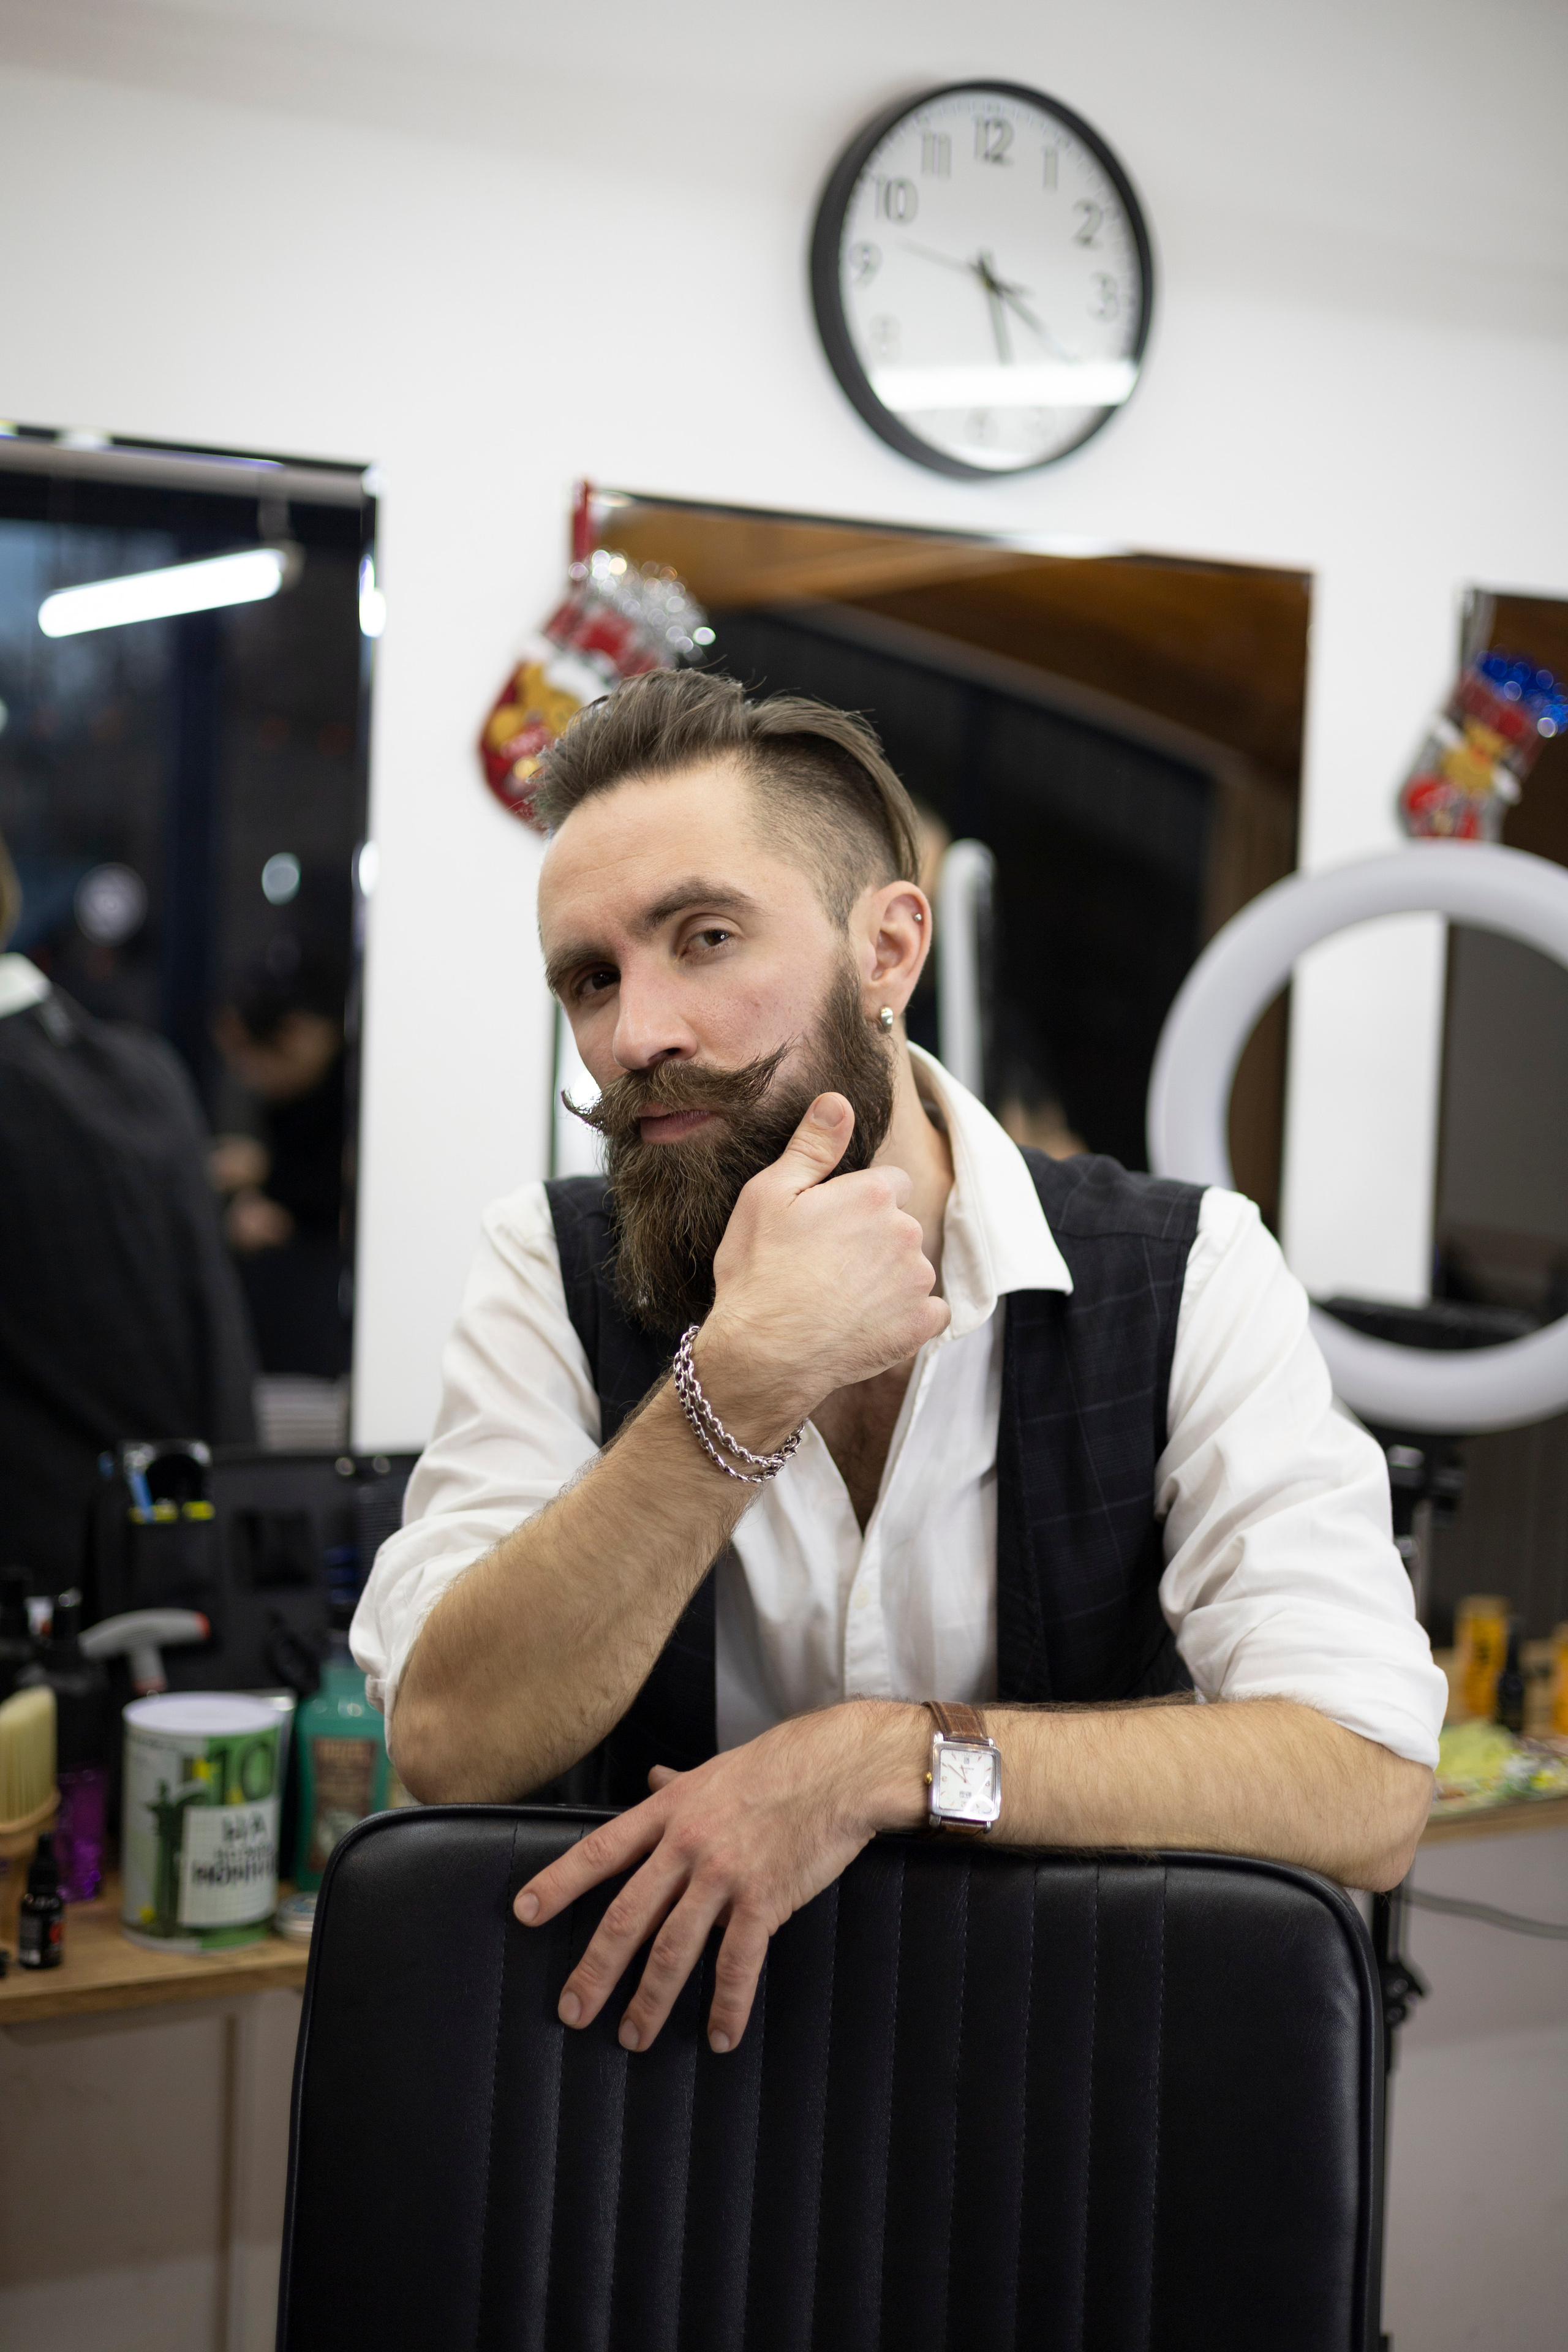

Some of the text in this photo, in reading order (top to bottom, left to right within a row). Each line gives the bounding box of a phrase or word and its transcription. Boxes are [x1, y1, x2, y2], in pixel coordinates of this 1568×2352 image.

[921, 130, 951, 178] 11
[974, 116, 1014, 167] 12
[1043, 145, 1059, 192] 1
[875, 175, 919, 225] 10
[1072, 197, 1103, 249] 2
[848, 241, 883, 288] 9
[1087, 271, 1120, 323] 3
[868, 312, 903, 364] 8
[208, 1741, 275, 1805] 10
